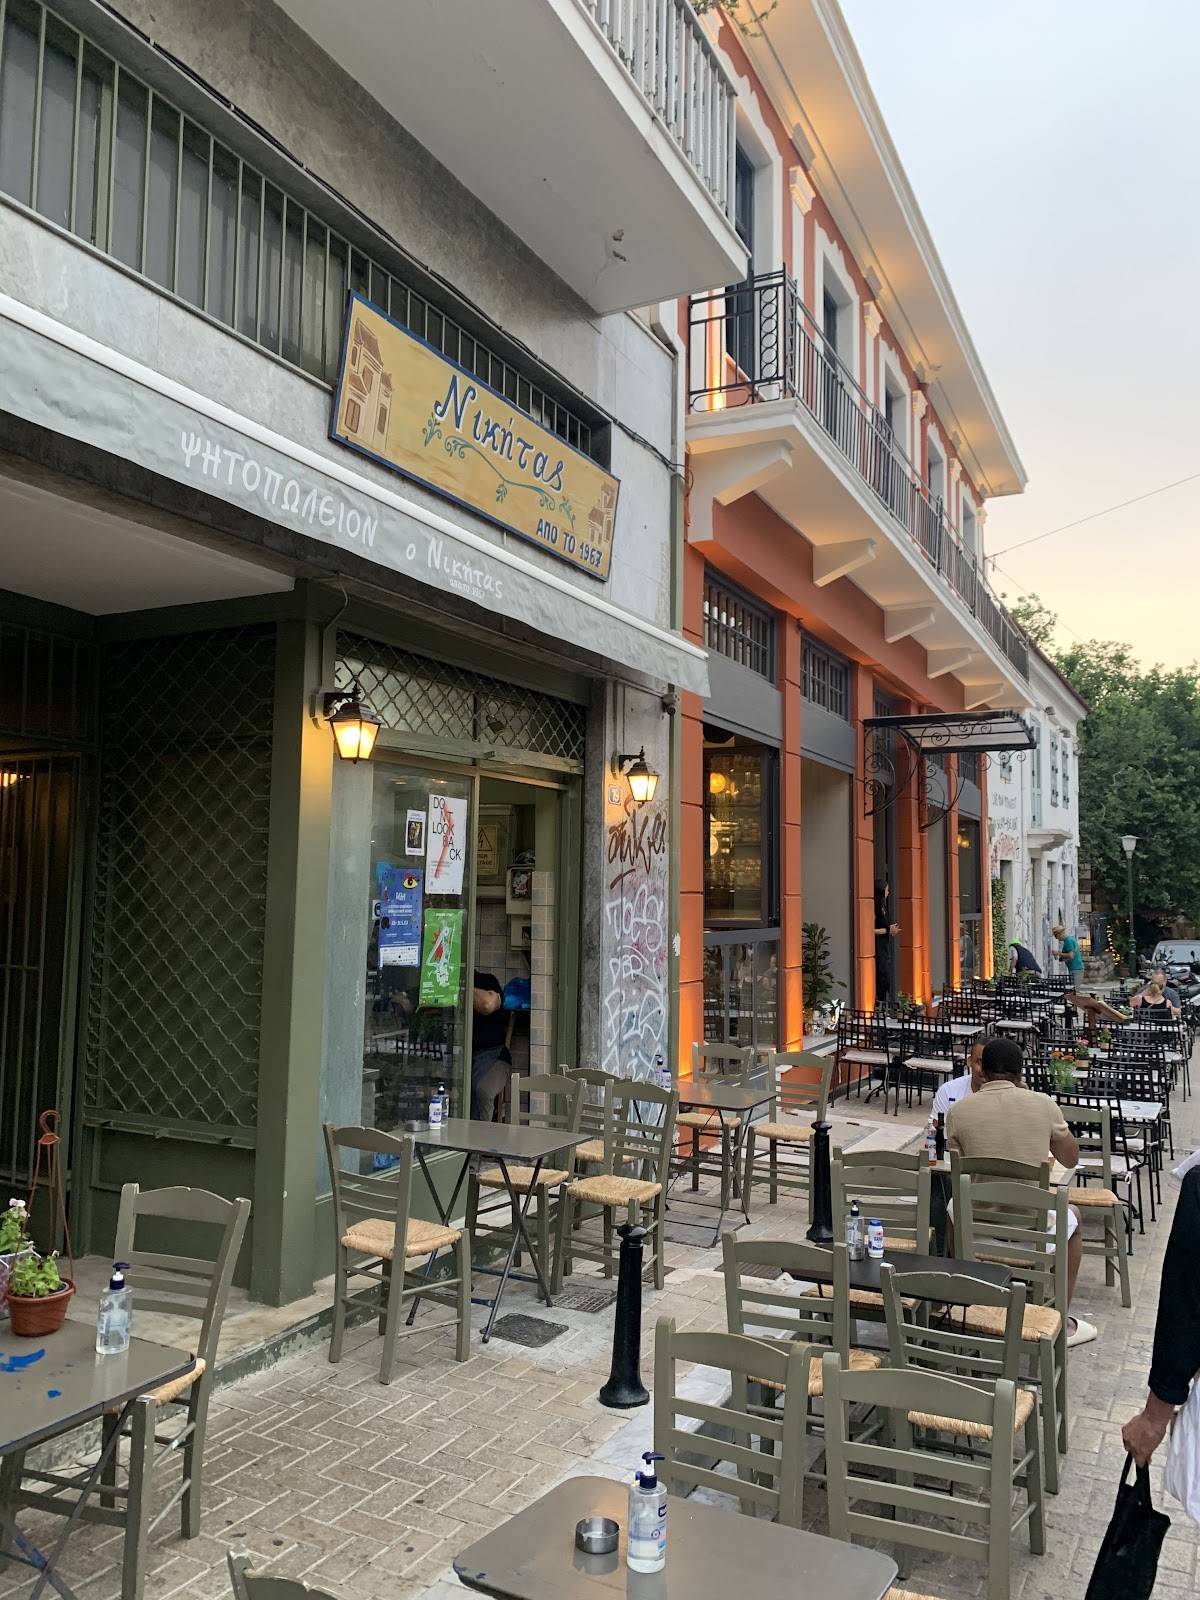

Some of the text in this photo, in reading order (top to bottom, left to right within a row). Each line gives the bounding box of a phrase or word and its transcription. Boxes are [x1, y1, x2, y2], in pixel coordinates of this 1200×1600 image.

[434, 374, 564, 492] Νικήτας
[181, 431, 378, 547] ΨΗΤΟΠΩΛΕΙΟΝ
[536, 518, 558, 544] ΑΠΟ
[563, 531, 576, 554] ΤΟ
[433, 796, 446, 809] DO
[432, 821, 455, 836] LOOK
[449, 848, 462, 861] CK
